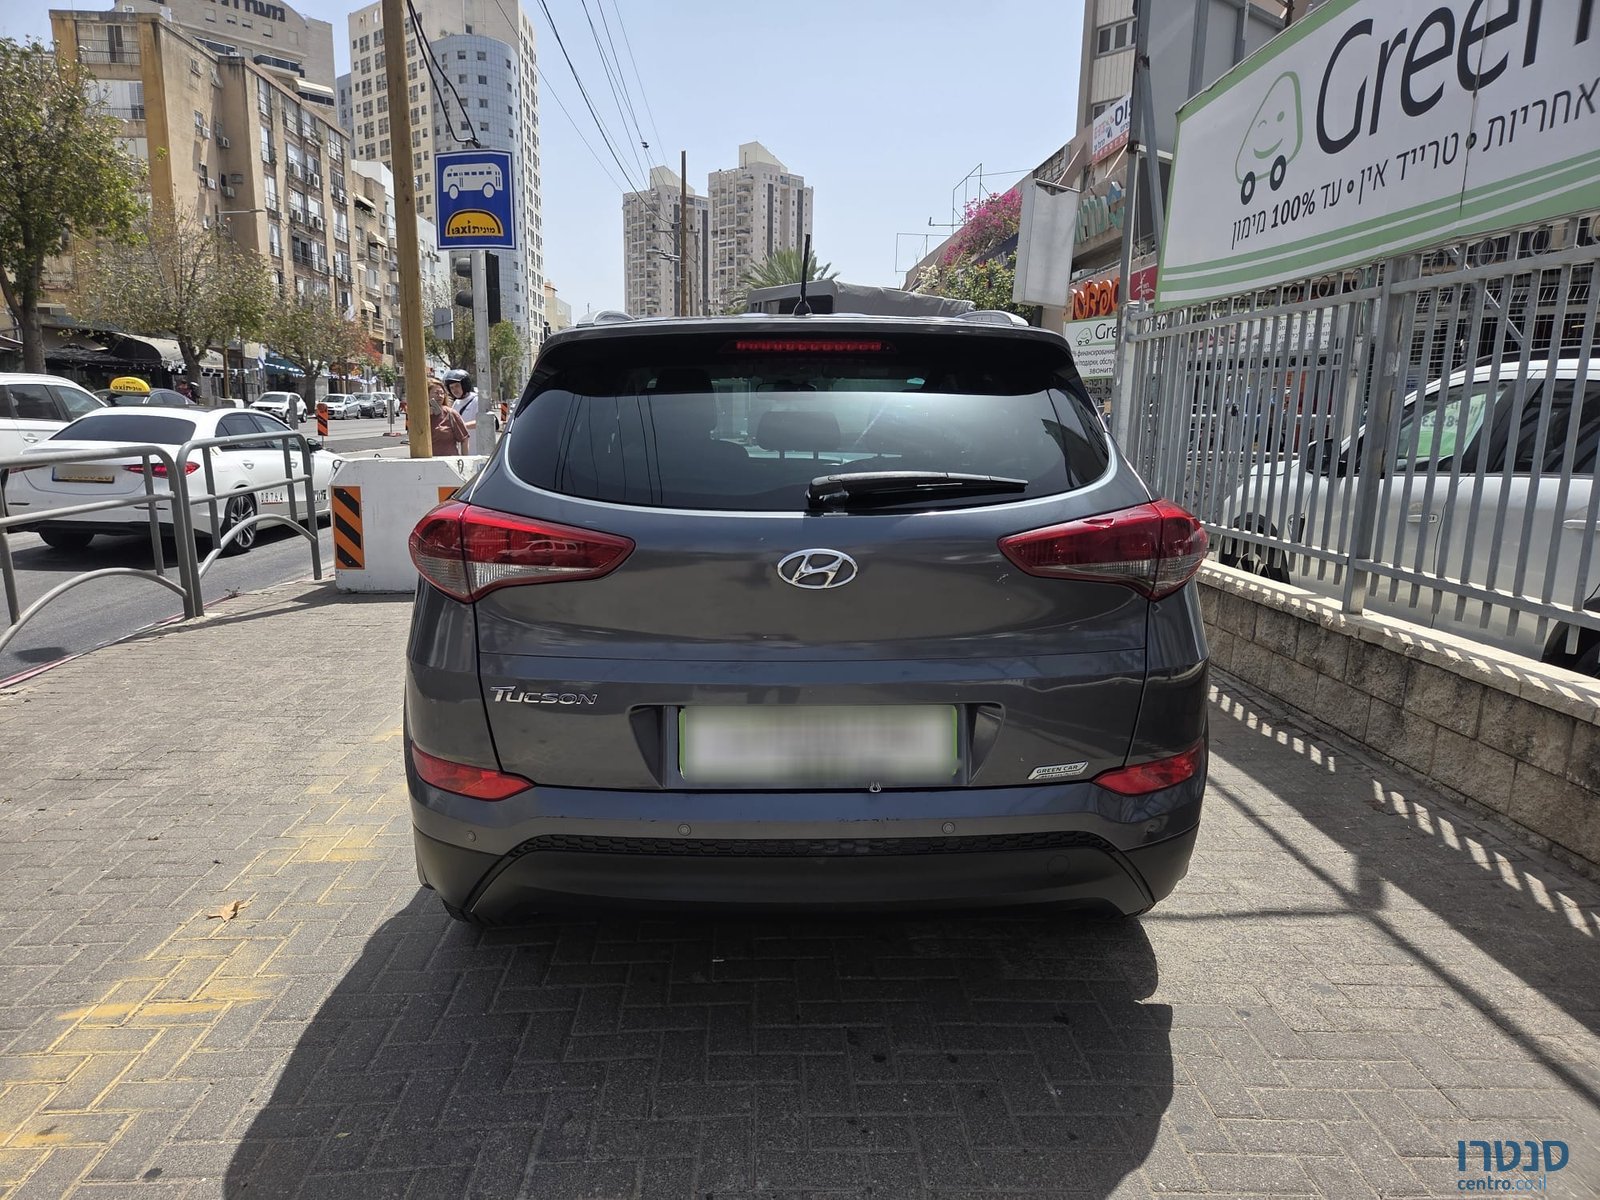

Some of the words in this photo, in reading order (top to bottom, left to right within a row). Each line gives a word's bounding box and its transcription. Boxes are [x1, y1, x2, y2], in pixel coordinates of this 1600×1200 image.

[1482, 76, 1600, 152] אחריות
[1396, 131, 1459, 181] טרייד
[1320, 178, 1343, 211] עד
[1357, 158, 1390, 205] אין
[1231, 210, 1268, 251] מימון
[1270, 188, 1316, 229] 100%
